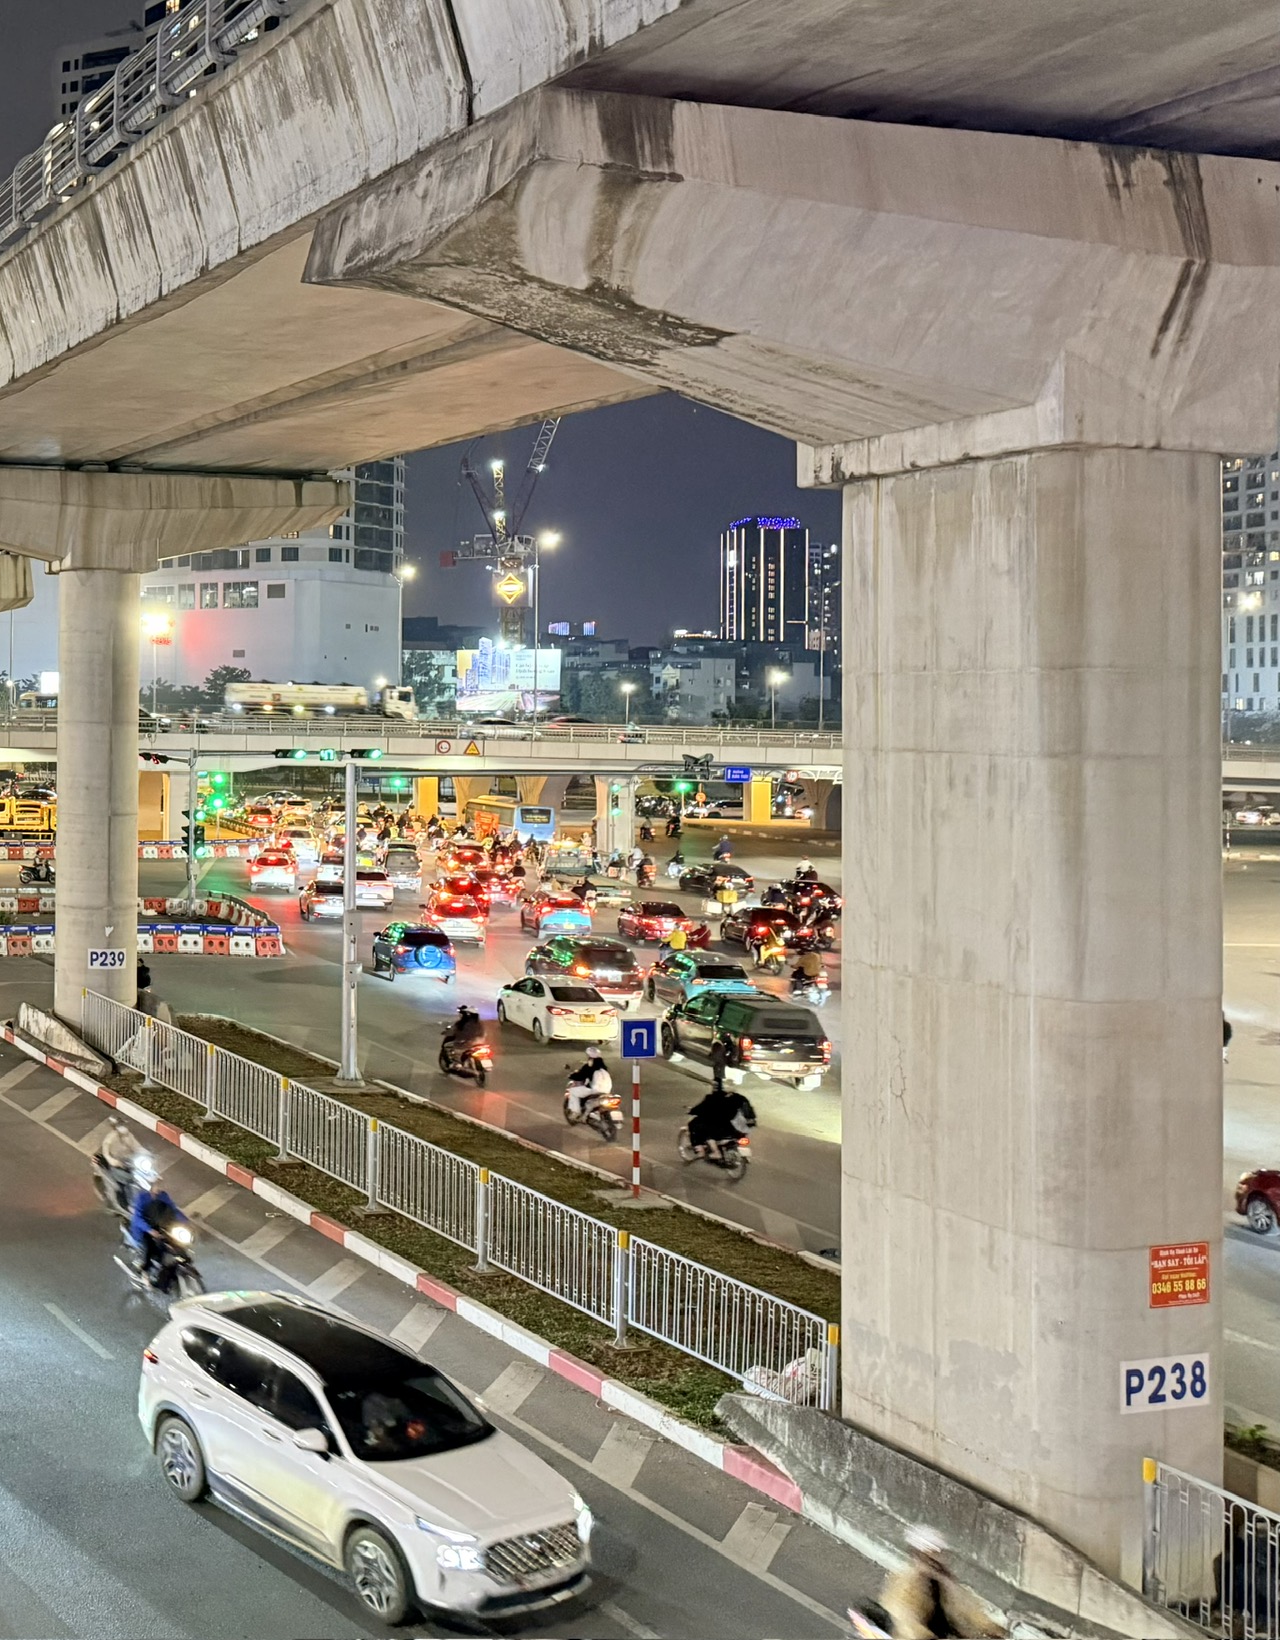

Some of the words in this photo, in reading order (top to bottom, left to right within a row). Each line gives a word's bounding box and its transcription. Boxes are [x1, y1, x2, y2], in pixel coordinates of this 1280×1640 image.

[90, 951, 124, 966] P239
[1167, 1258, 1180, 1267] SAY
[1152, 1282, 1172, 1294] 0346
[1173, 1280, 1183, 1292] 55
[1185, 1279, 1195, 1291] 88
[1196, 1278, 1206, 1290] 66
[1126, 1360, 1207, 1406] P238
